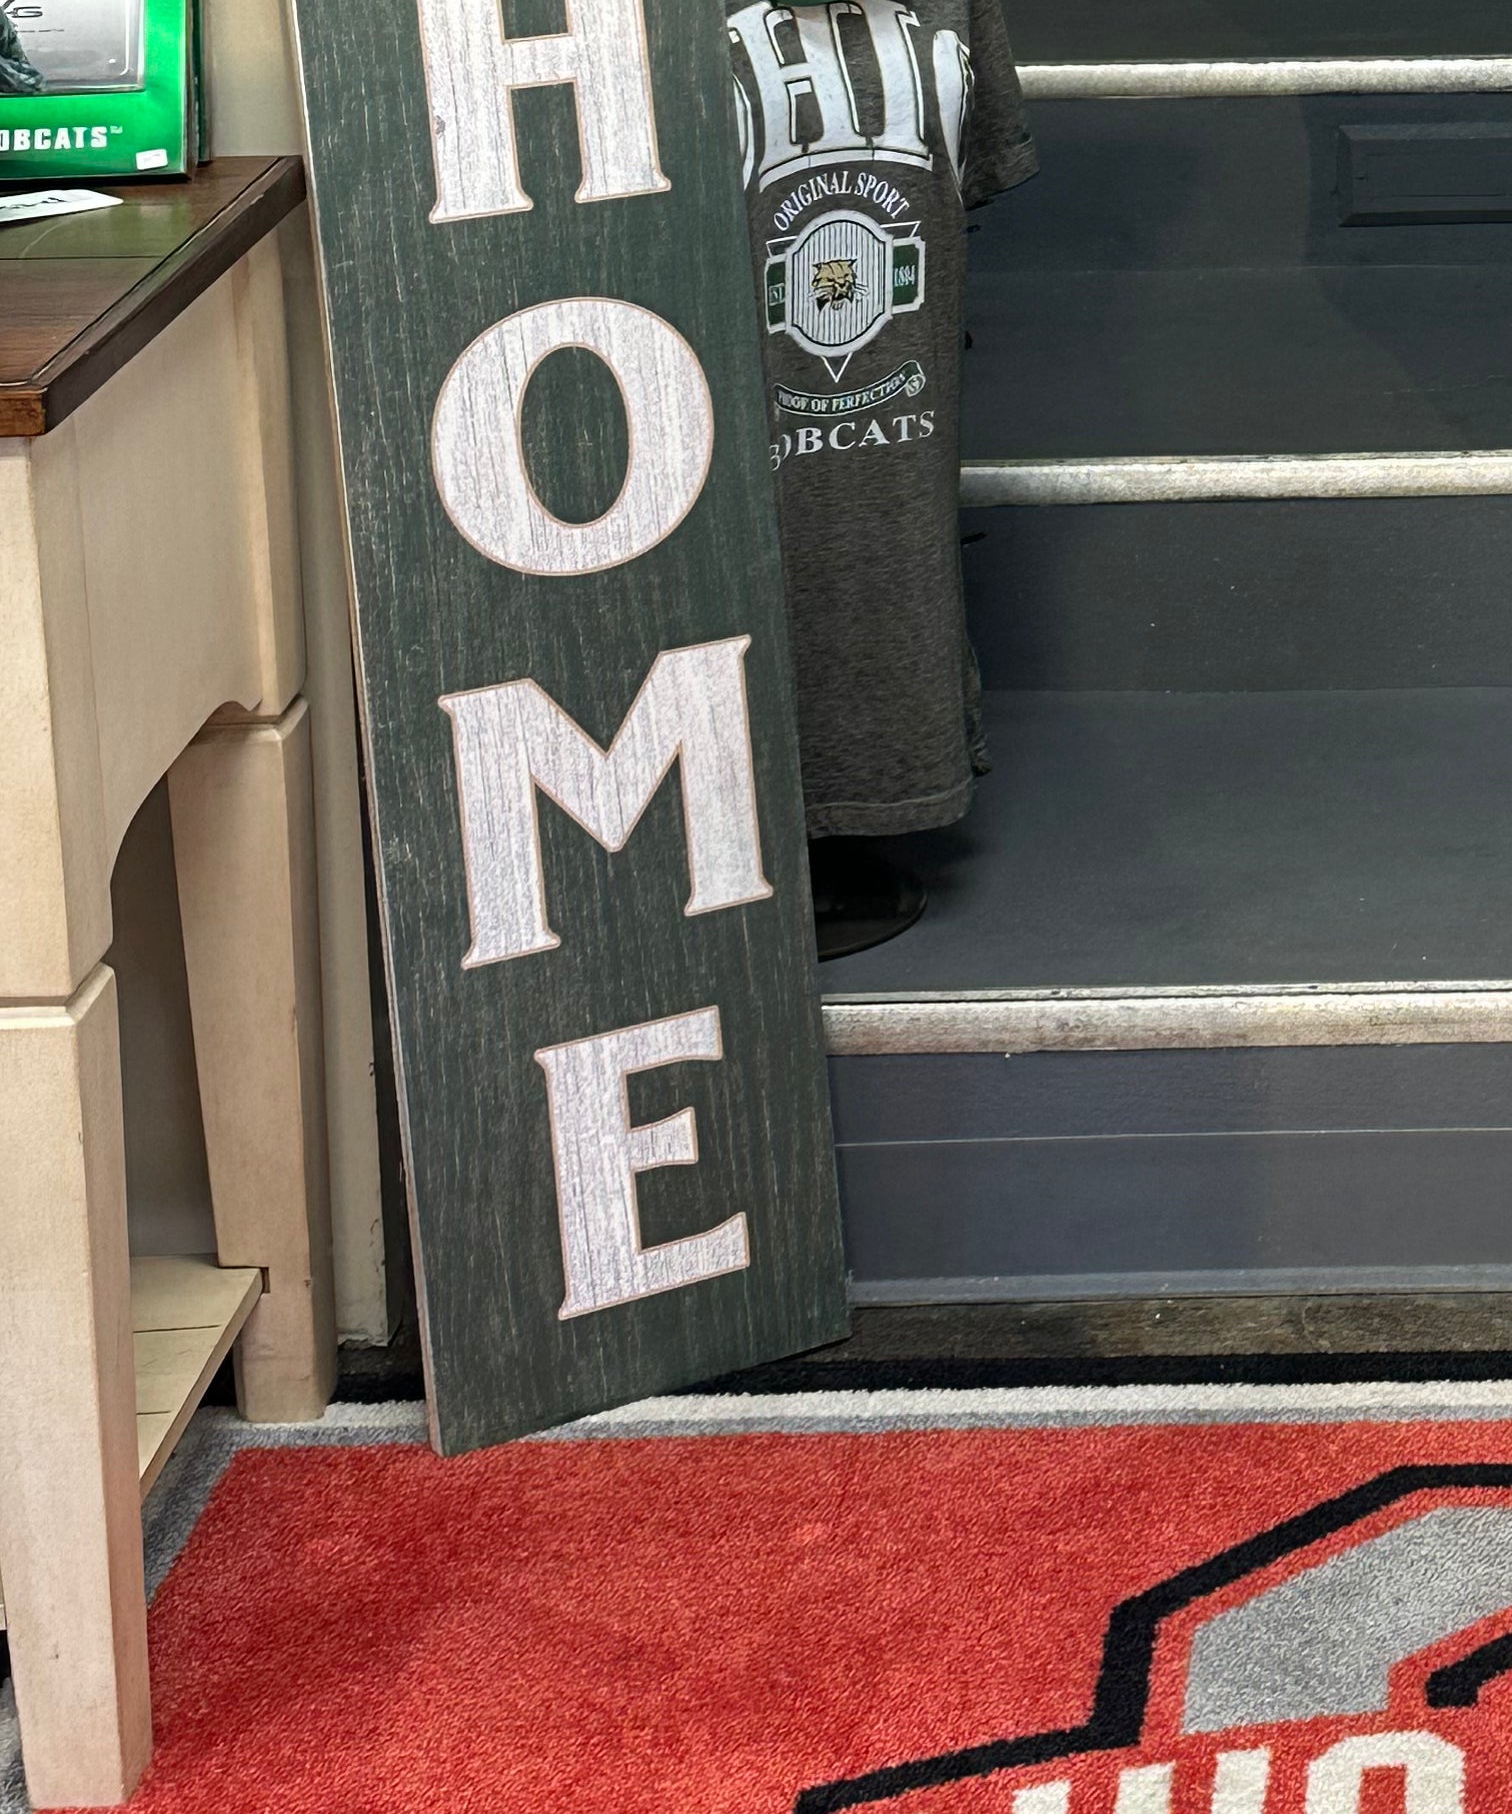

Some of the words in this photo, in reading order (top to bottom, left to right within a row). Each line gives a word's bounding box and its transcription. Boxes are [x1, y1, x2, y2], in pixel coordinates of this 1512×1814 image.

[773, 170, 851, 232] ORIGINAL
[854, 172, 910, 220] SPORT
[811, 398, 830, 413] OF
